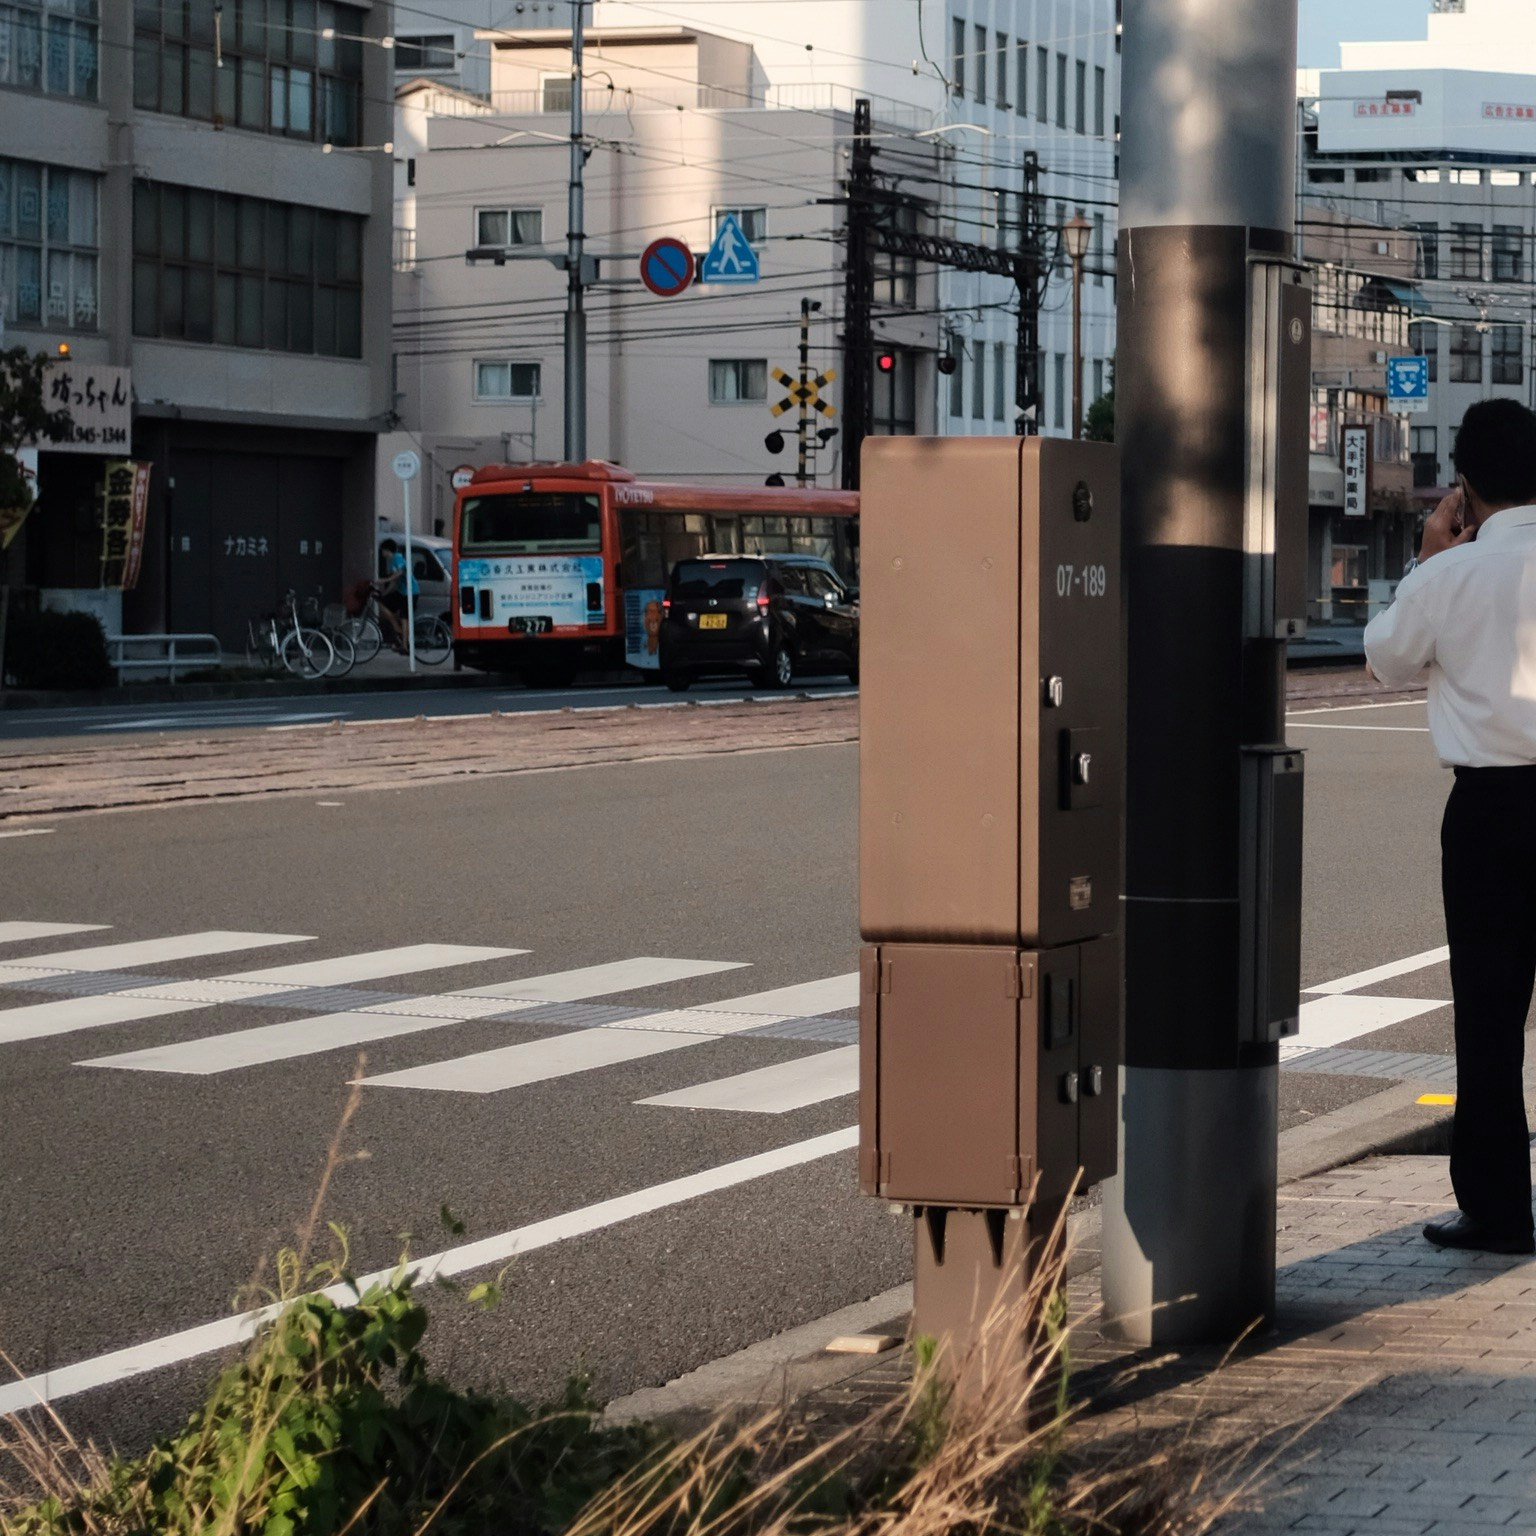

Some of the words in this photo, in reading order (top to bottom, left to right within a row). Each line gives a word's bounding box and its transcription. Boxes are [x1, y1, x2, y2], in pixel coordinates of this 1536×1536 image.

[52, 372, 127, 413] 坊っちゃん
[1346, 435, 1359, 509] 大手町薬局
[106, 466, 133, 584] 金券各
[224, 534, 269, 557] ナカミネ
[1057, 564, 1106, 597] 07-189
